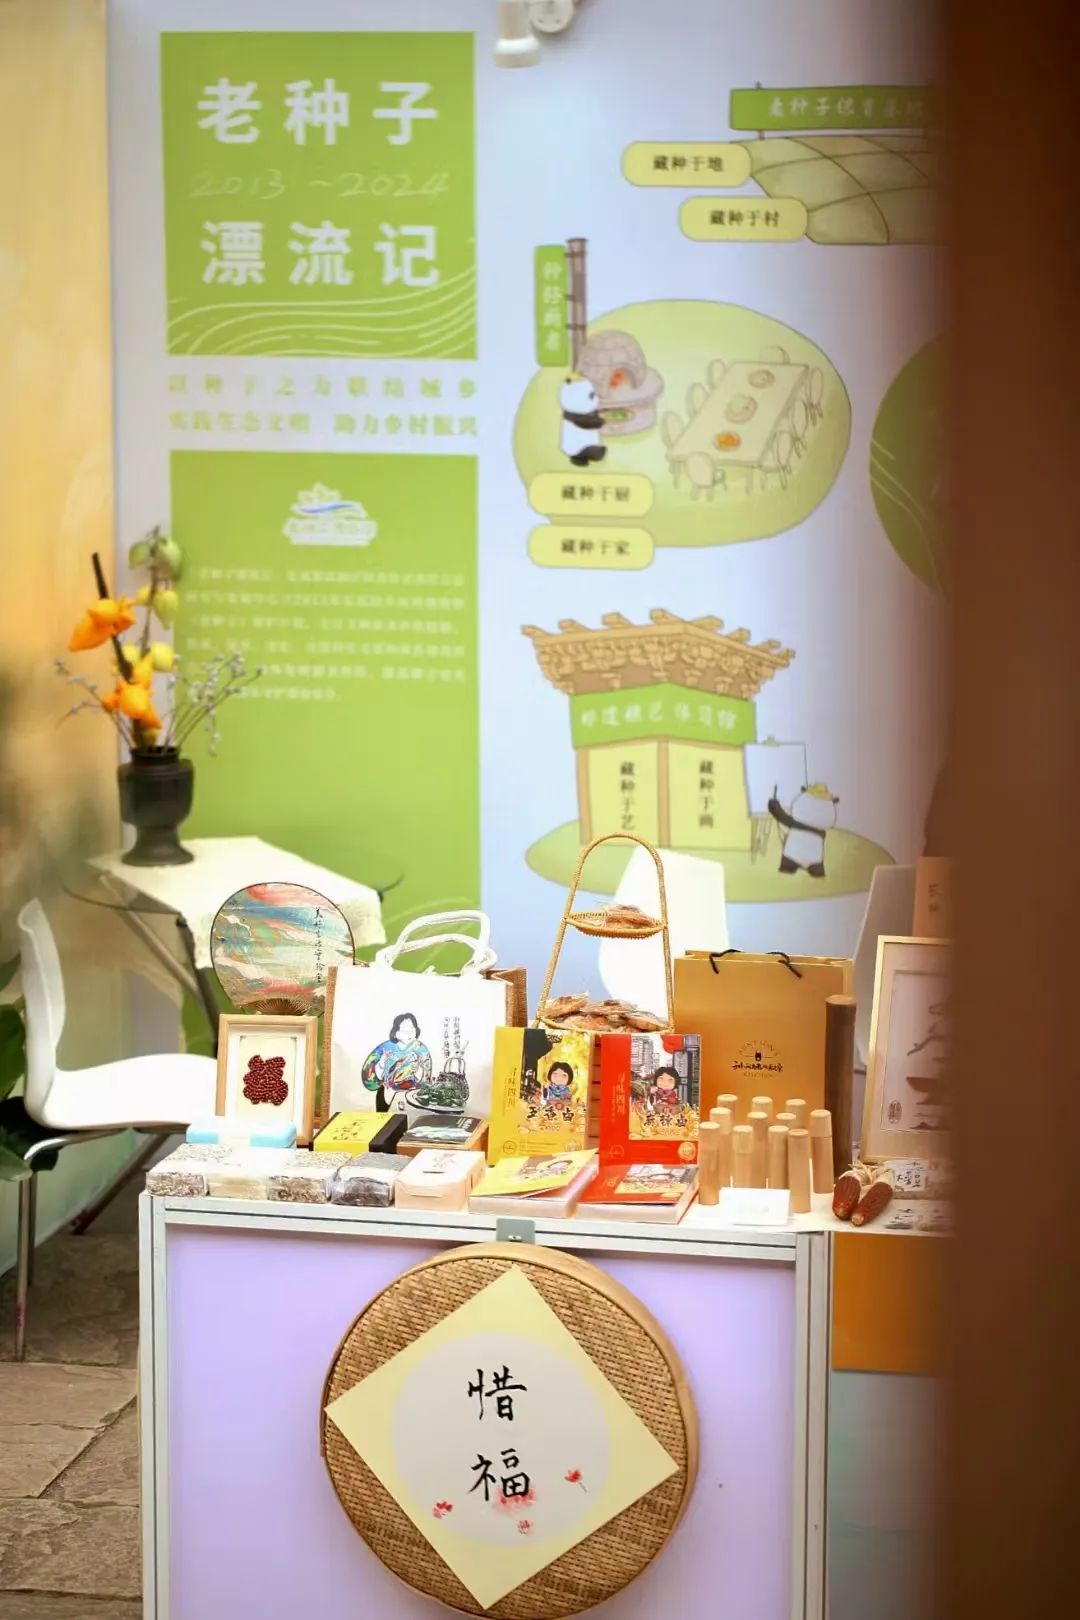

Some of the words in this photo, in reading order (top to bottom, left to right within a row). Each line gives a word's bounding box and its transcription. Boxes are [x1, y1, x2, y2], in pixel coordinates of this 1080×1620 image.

[197, 77, 439, 146] 老种子
[652, 153, 724, 172] 藏种于地
[708, 208, 780, 227] 藏种于村
[200, 220, 440, 287] 漂流记
[466, 1364, 531, 1502] 惜福
